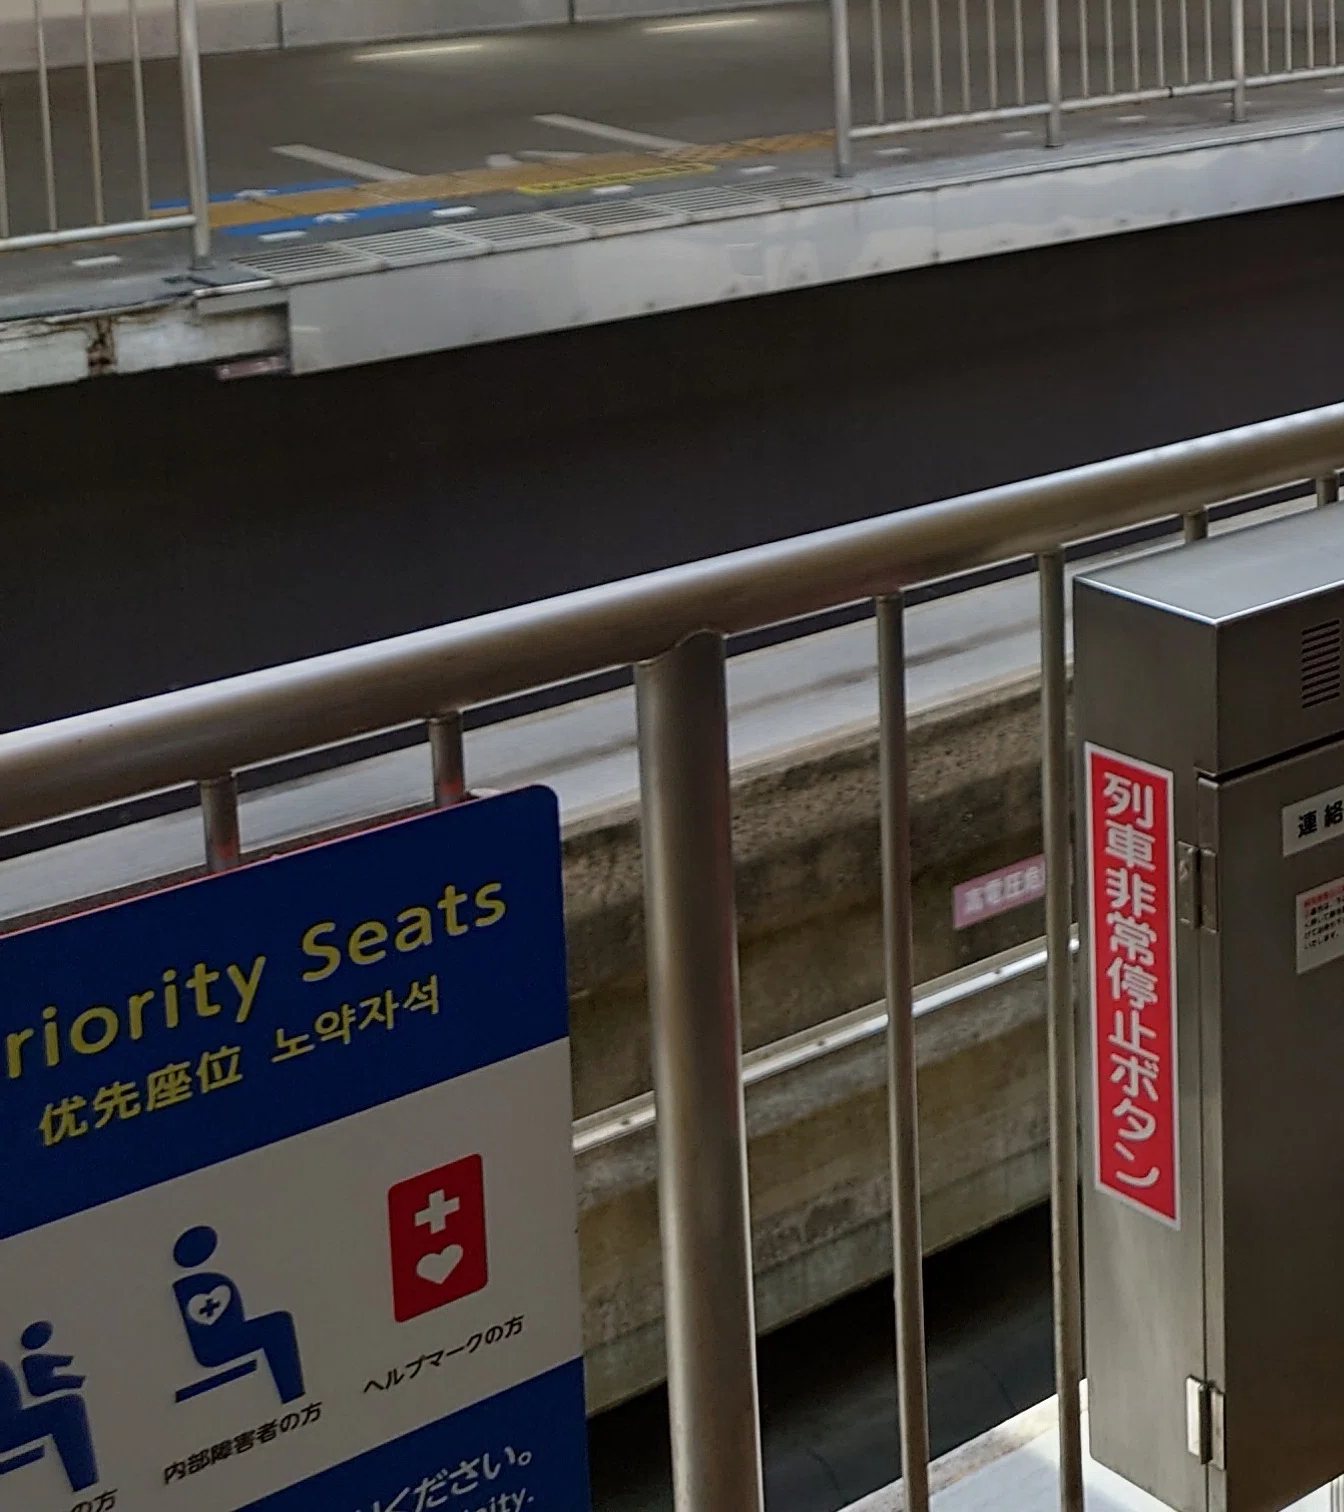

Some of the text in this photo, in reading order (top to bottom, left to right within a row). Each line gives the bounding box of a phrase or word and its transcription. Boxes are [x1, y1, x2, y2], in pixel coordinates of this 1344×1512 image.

[302, 881, 507, 984] Seats
[270, 974, 442, 1062] 노약자석
[1102, 771, 1162, 1190] 列車非常停止ボタン
[38, 1046, 243, 1147] 优先座位
[363, 1315, 525, 1394] ヘルプマークの方
[163, 1402, 323, 1485] 内部障害者の方
